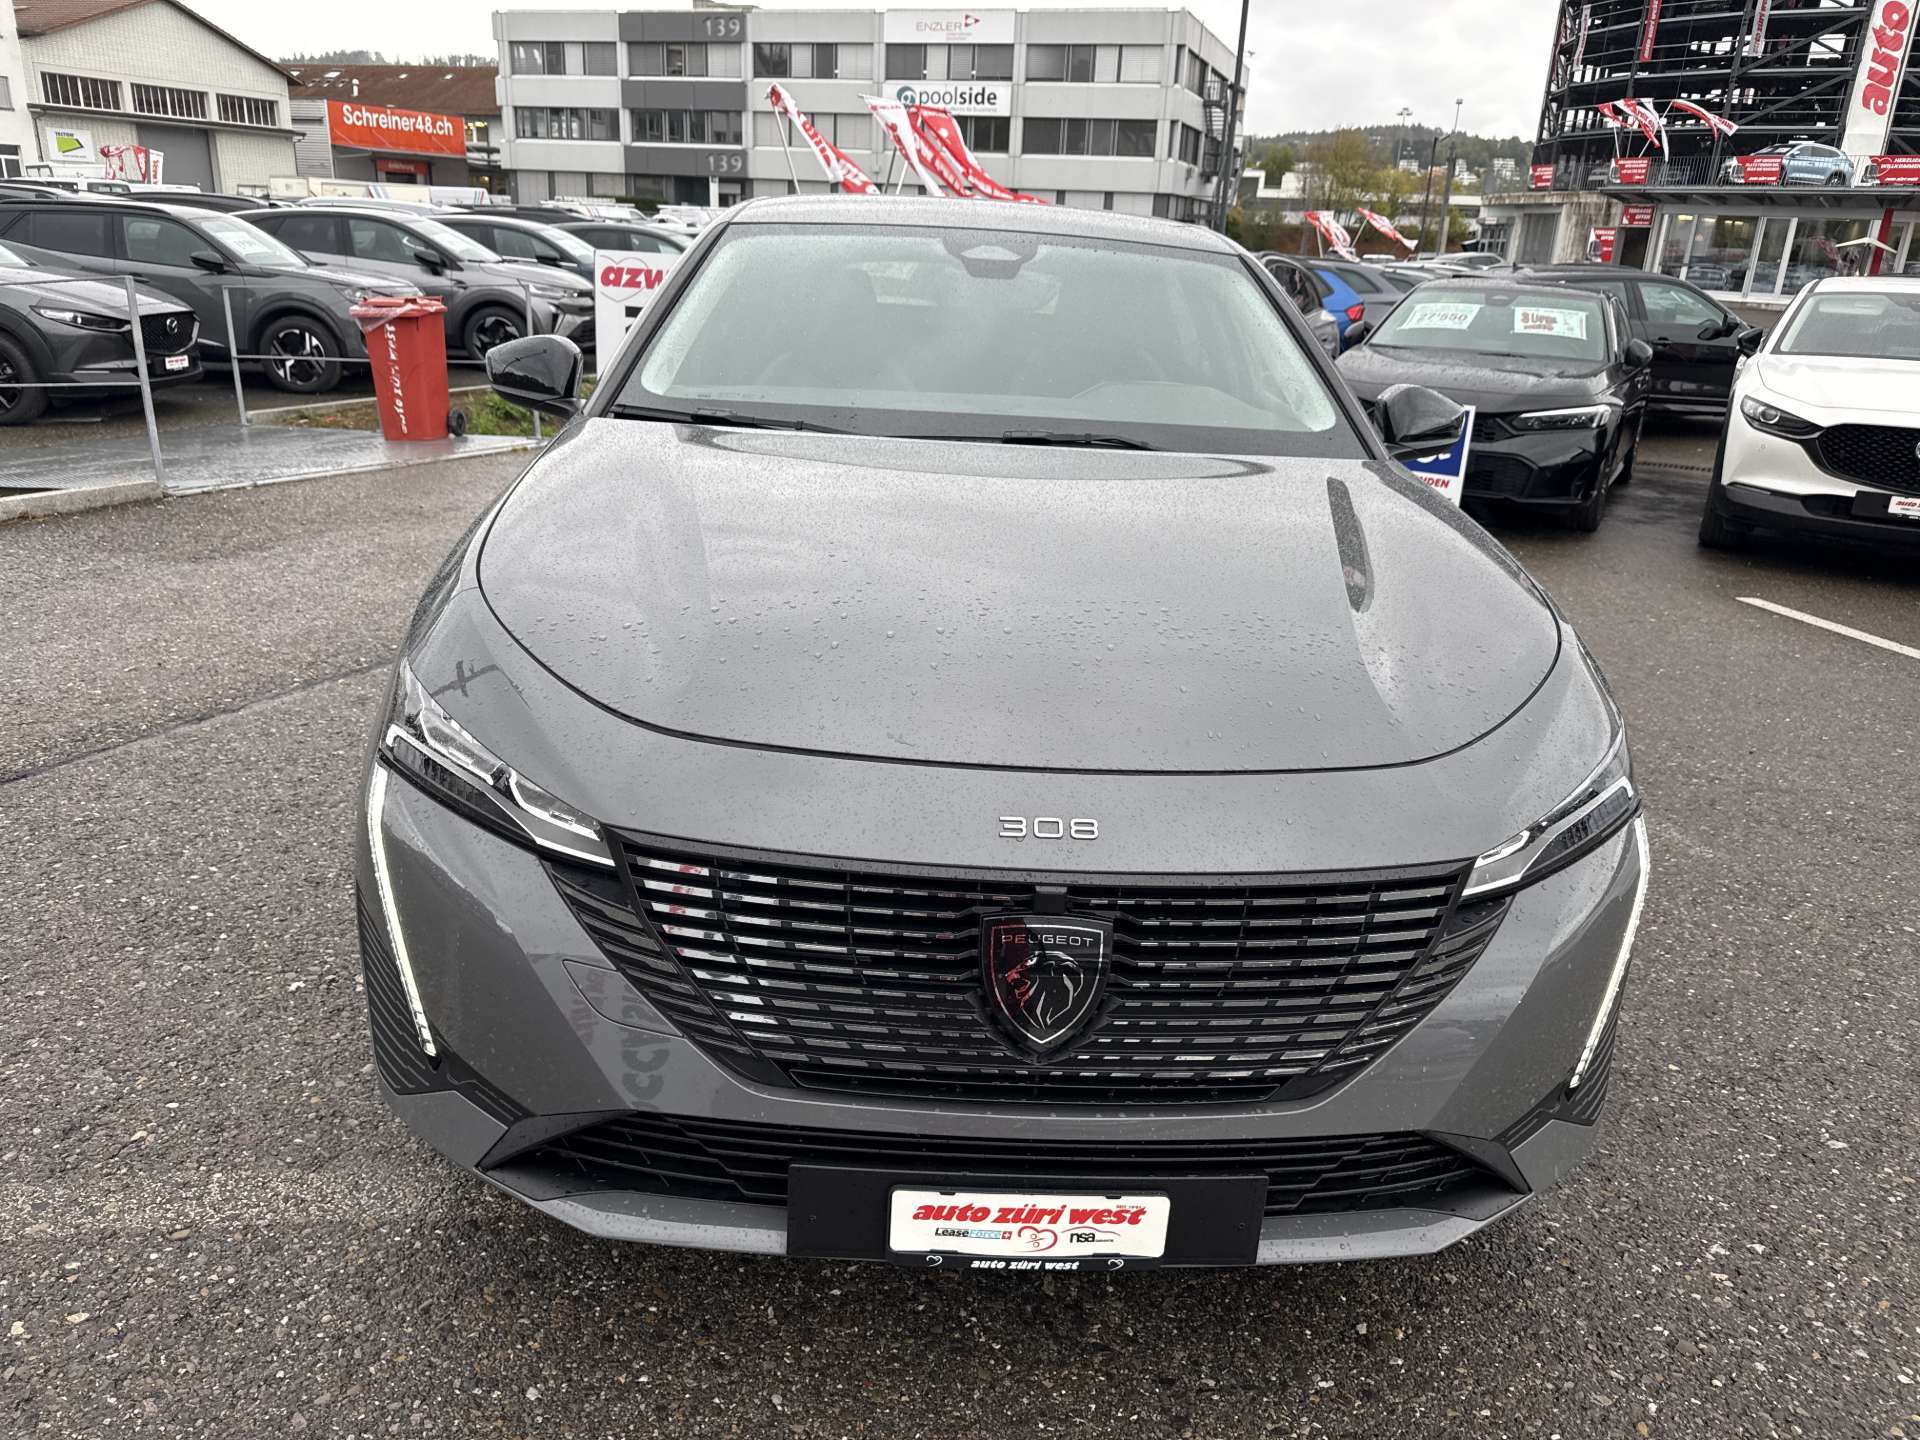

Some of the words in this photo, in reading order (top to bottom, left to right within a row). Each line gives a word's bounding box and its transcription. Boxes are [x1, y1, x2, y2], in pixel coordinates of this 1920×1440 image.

[705, 17, 741, 37] 139
[915, 21, 962, 32] ENZLER
[1862, 1, 1909, 115] auto
[919, 86, 998, 106] poolside
[343, 104, 454, 137] Schreiner48.ch
[708, 154, 743, 173] 139
[999, 815, 1100, 840] 308
[1001, 934, 1094, 948] PEUGEOT
[912, 1203, 991, 1222] auto
[991, 1203, 1067, 1225] züri
[1069, 1207, 1147, 1226] west
[935, 1227, 1001, 1240] LeaseForce
[1070, 1232, 1096, 1243] nsa
[970, 1259, 1006, 1270] auto
[1008, 1259, 1042, 1271] züri
[1044, 1261, 1080, 1271] west
